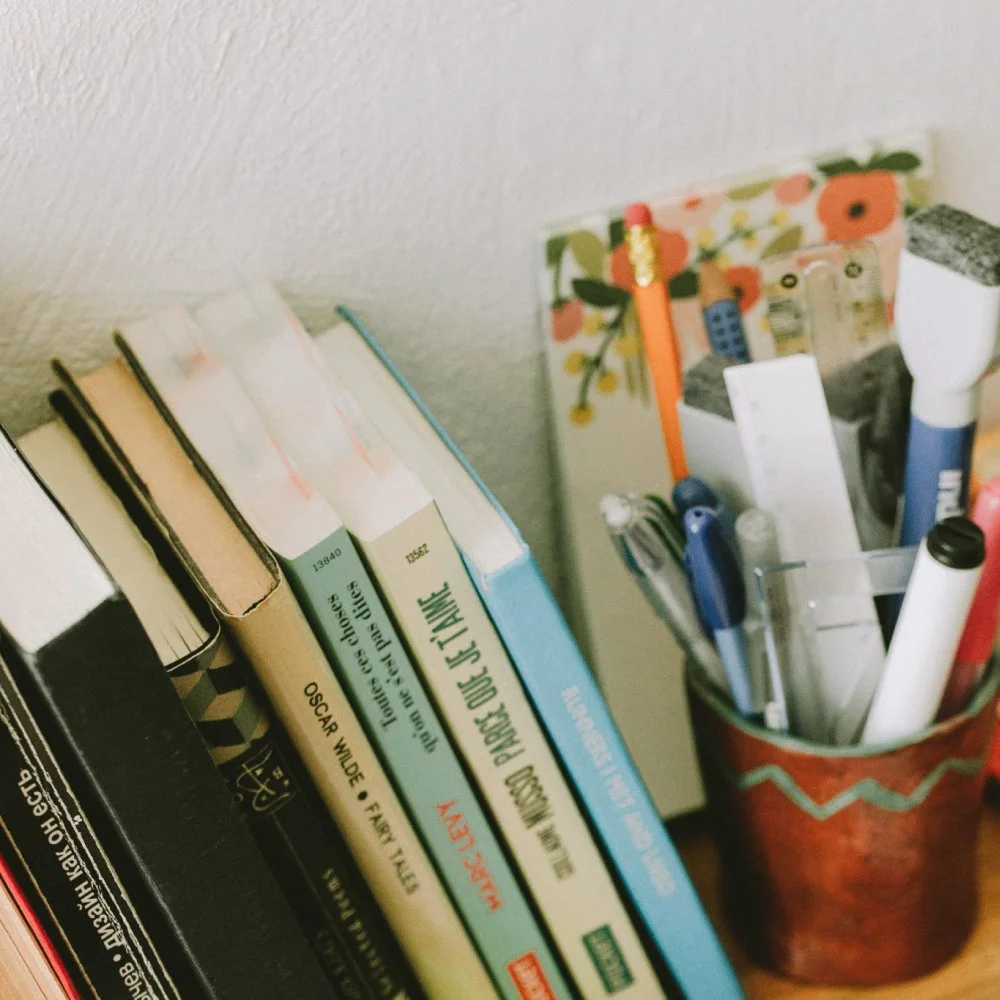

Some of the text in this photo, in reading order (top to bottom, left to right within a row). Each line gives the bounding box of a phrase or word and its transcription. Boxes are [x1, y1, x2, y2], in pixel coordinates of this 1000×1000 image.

[312, 547, 342, 572] 13840
[405, 543, 429, 564] 13562
[326, 592, 399, 730] Toutes ces choses
[346, 580, 440, 755] qu'on ne s'est pas dites
[415, 580, 526, 768] PARCE QUE JE T'AIME
[17, 768, 48, 817] есть
[303, 681, 420, 895] OSCAR WILDE FAIRY TALES
[503, 764, 550, 830] MUSSO
[40, 816, 66, 845] он
[55, 844, 84, 882] как
[430, 799, 503, 917] MARC LEVY
[74, 880, 125, 951] дизайн
